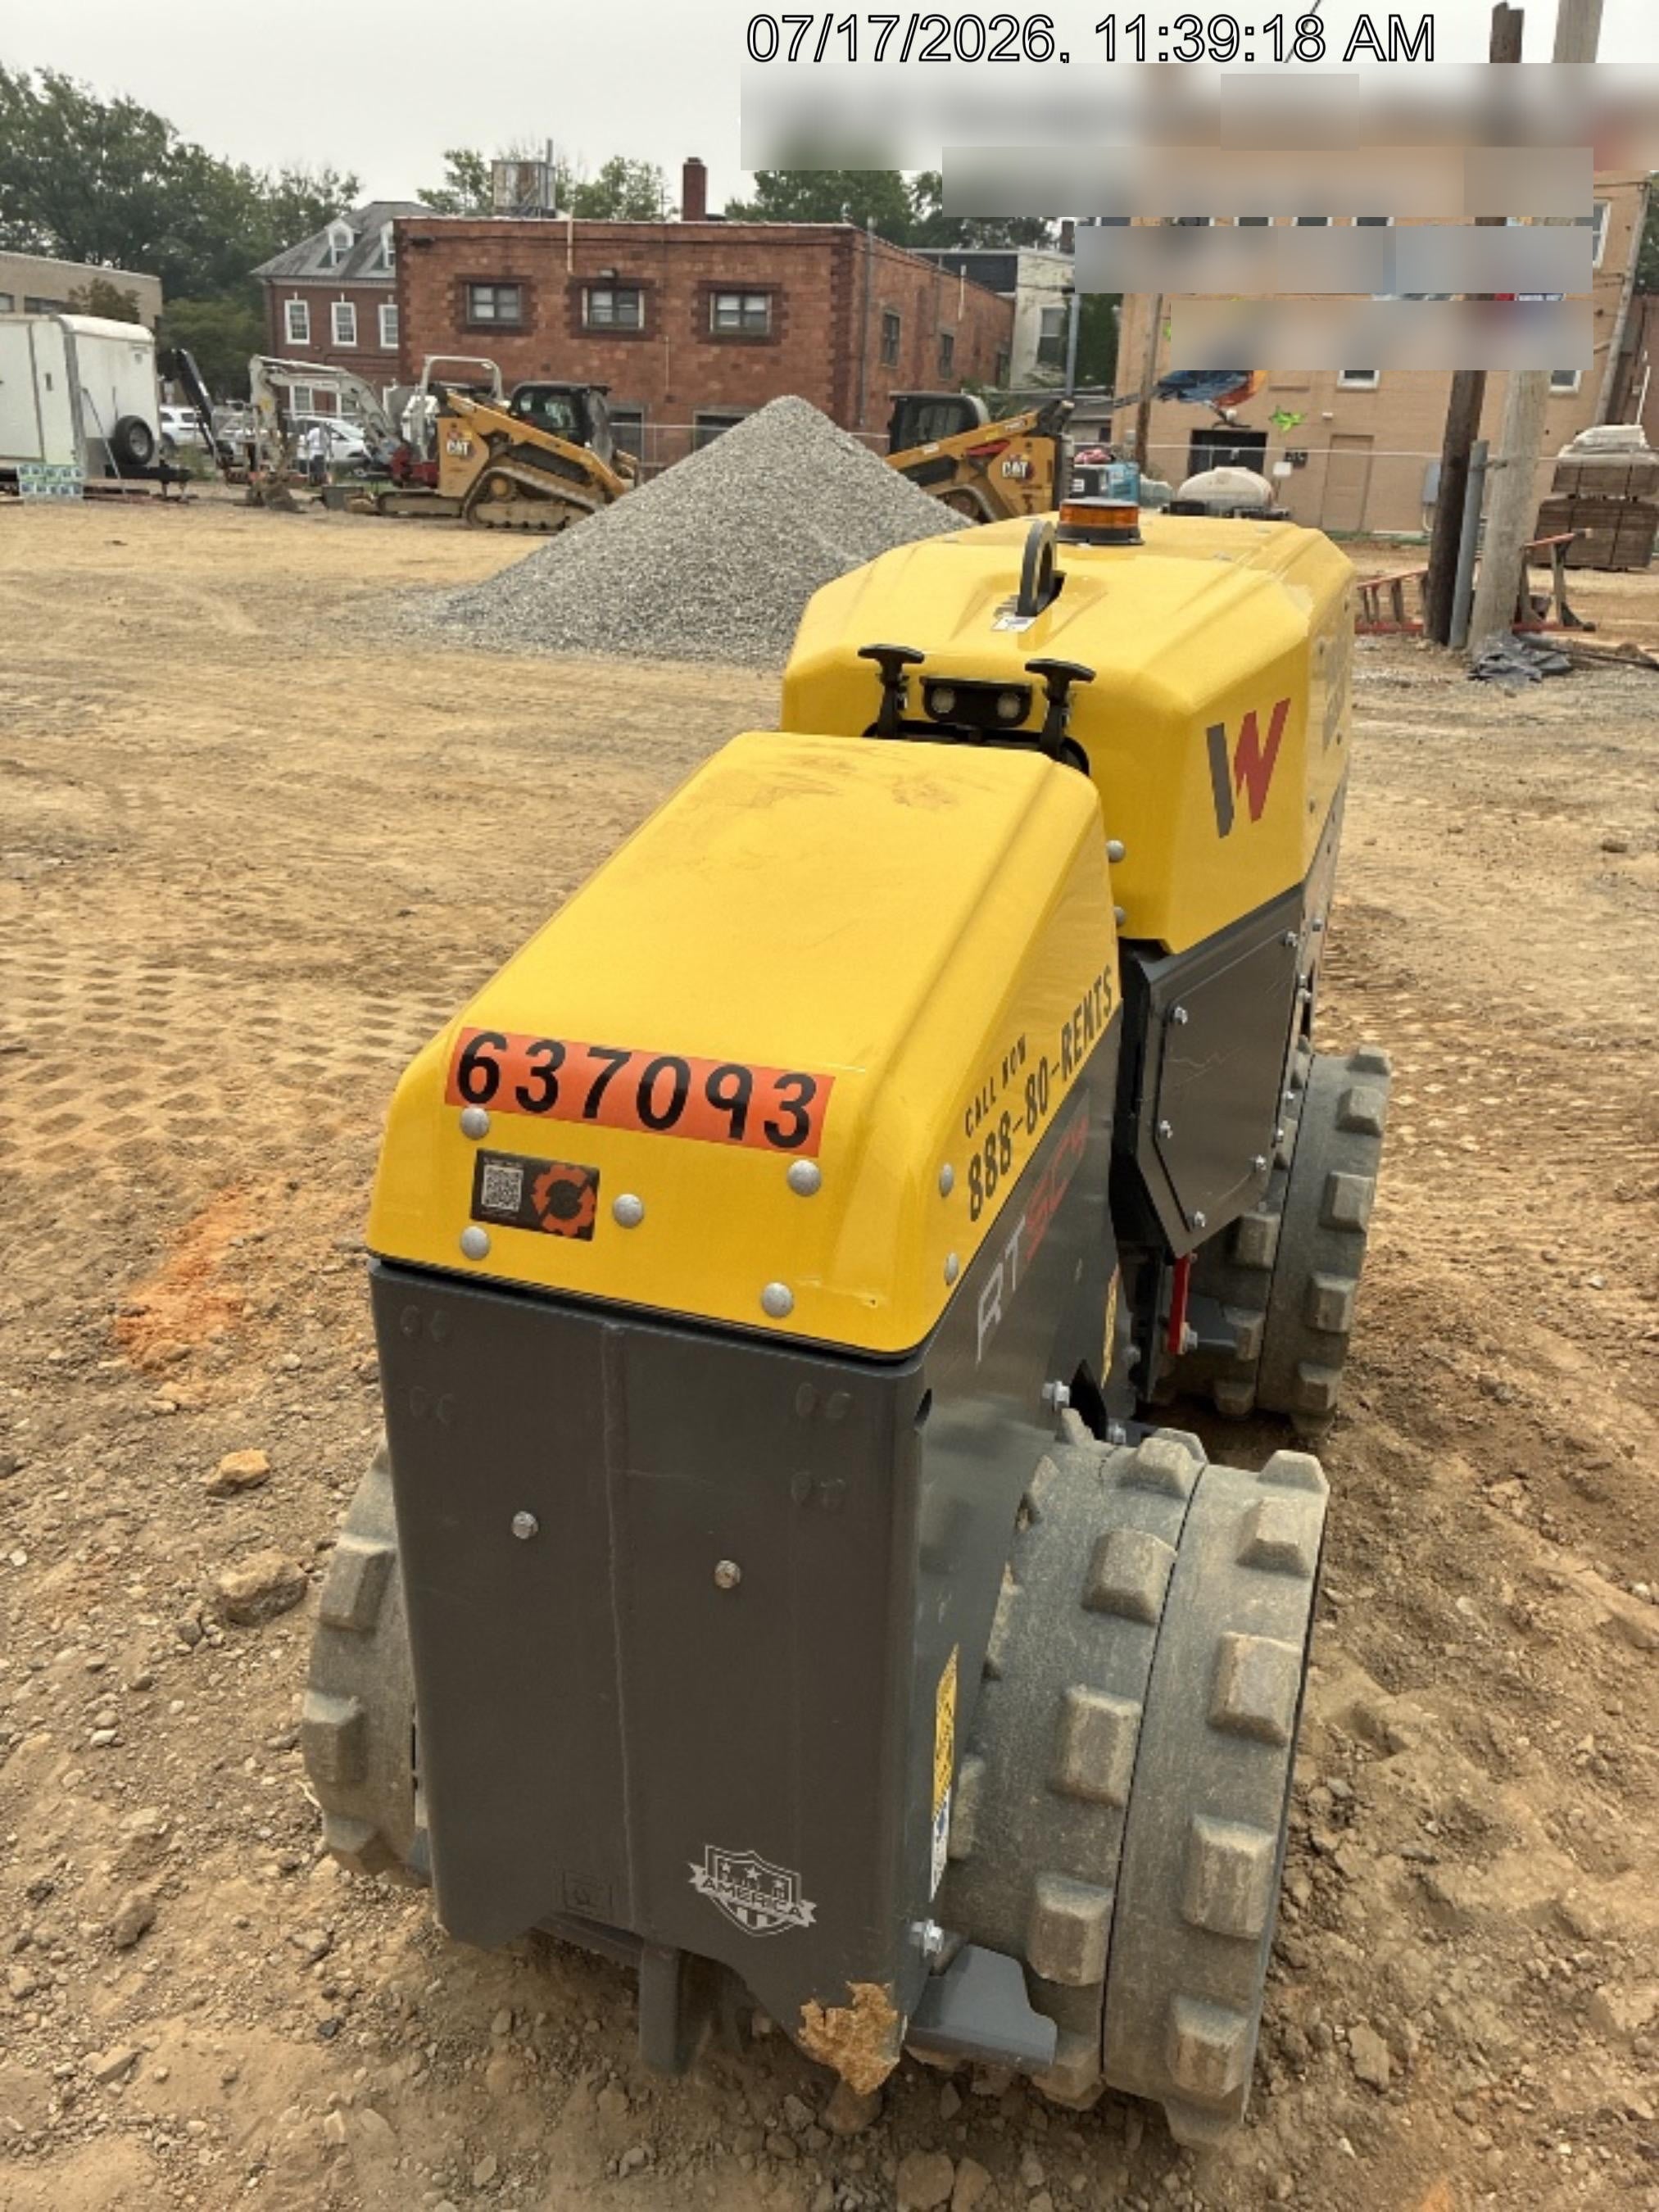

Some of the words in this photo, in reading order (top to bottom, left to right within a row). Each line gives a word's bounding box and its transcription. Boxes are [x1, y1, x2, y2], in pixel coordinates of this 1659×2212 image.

[1002, 460, 1029, 478] CAT
[456, 1031, 818, 1149] 637093
[965, 1076, 996, 1138] CALL
[1002, 1031, 1026, 1089] NOW
[968, 963, 1112, 1222] 888-80-RENTS
